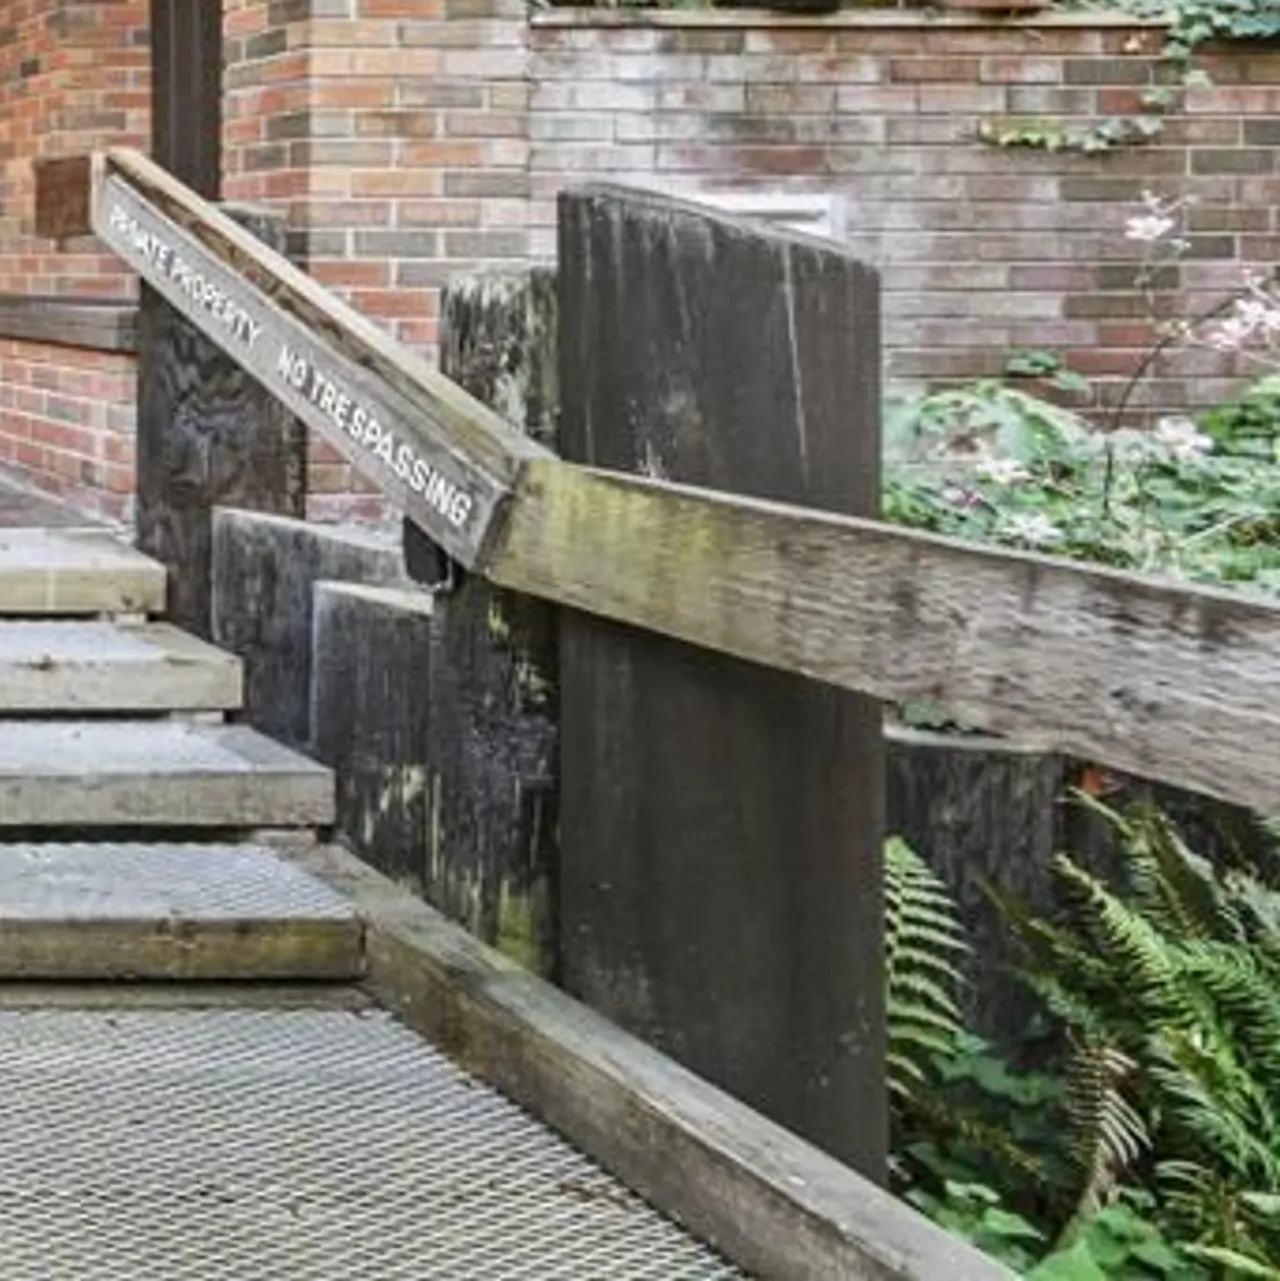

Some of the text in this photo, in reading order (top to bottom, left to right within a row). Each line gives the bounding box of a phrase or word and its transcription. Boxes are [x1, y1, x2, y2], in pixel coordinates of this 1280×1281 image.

[170, 256, 262, 349] PROPERTY
[277, 345, 307, 388] NO
[310, 371, 473, 526] TRESPASSING
